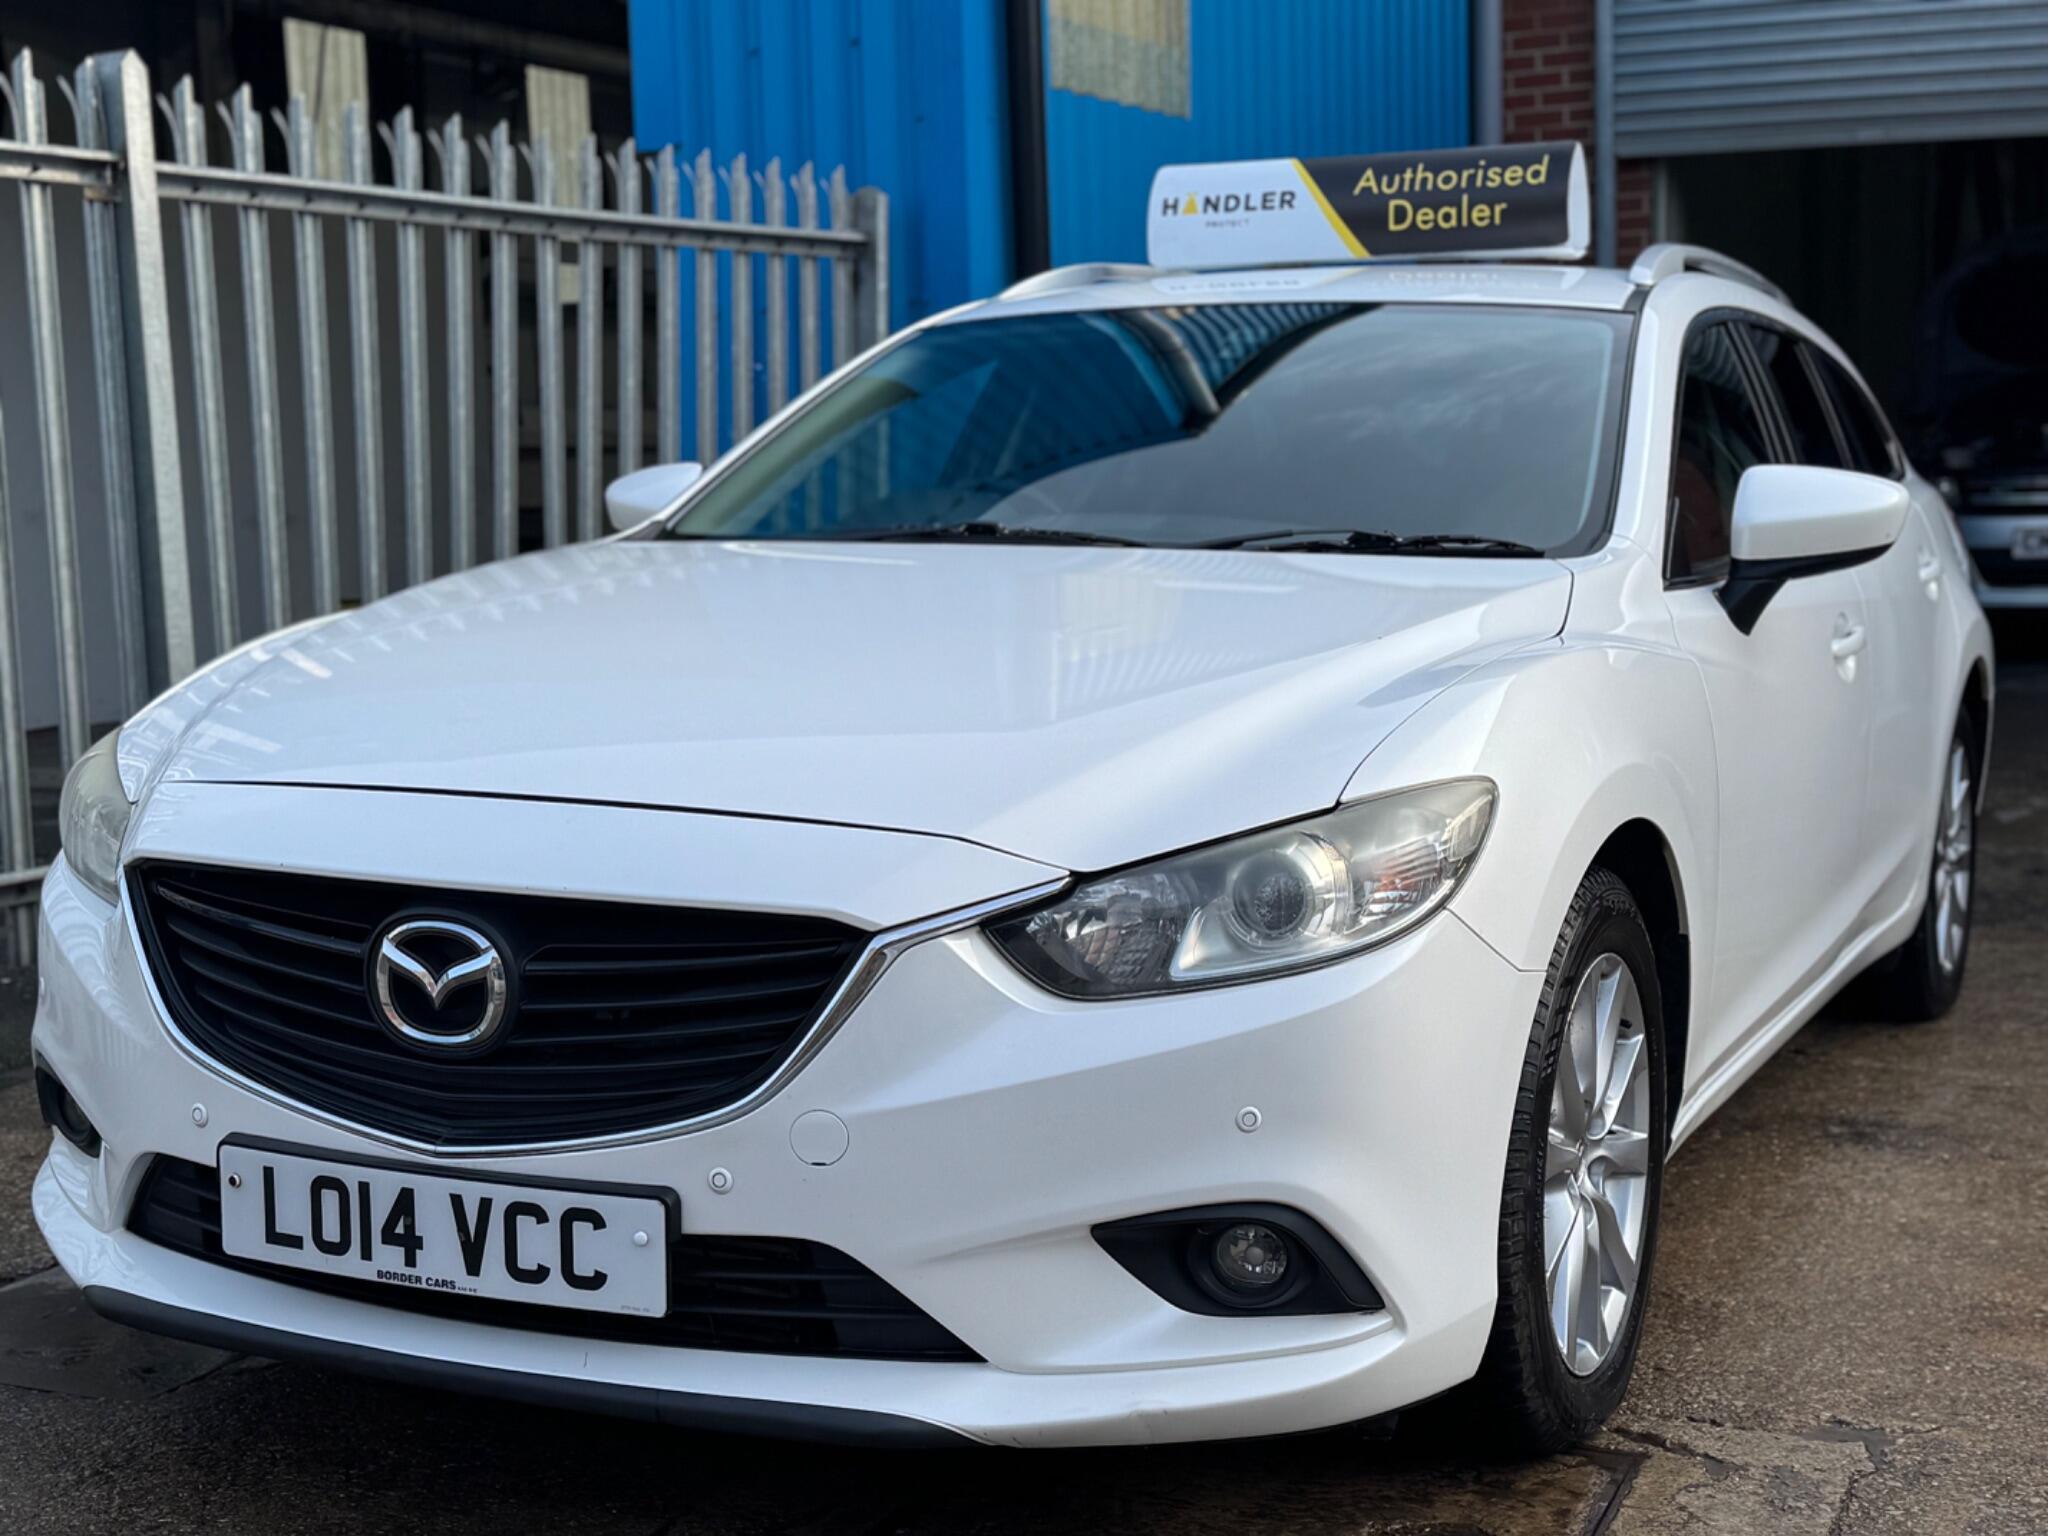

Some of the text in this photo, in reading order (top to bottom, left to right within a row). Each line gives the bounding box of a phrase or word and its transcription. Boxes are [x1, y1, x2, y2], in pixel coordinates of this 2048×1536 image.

[1353, 154, 1550, 196] Authorised
[1388, 194, 1507, 232] Dealer
[263, 1166, 608, 1291] LO14 VCC
[377, 1270, 422, 1285] BORDER
[425, 1277, 456, 1290] CARS
